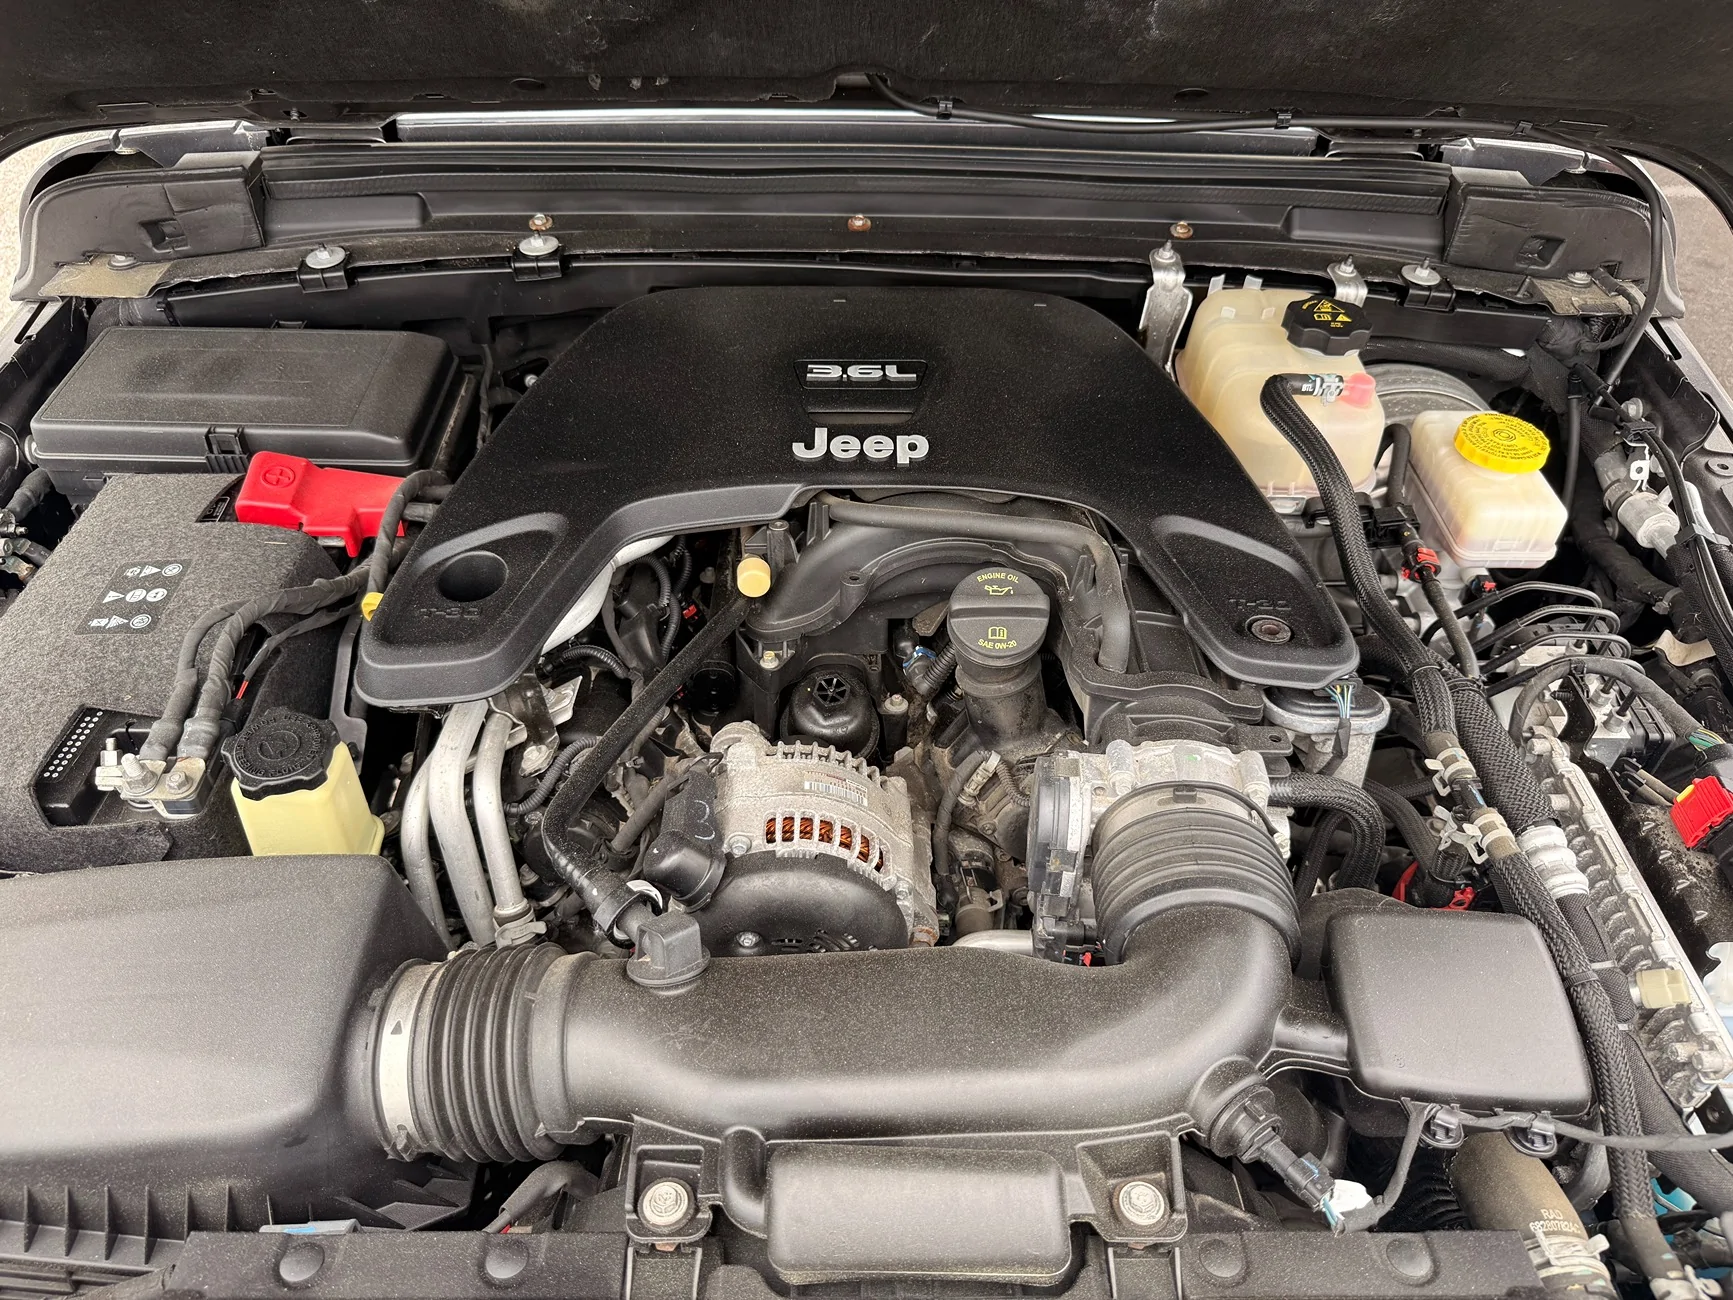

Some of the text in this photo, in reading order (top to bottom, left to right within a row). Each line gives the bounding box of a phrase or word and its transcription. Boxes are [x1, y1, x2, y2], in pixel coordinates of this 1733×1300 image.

[806, 364, 917, 382] 3.6L
[792, 427, 930, 467] Jeep
[976, 572, 1019, 583] ENGINE OIL
[977, 638, 1018, 650] SAE 0W-20
[236, 743, 266, 777] STEERING
[1540, 1208, 1564, 1220] RAD
